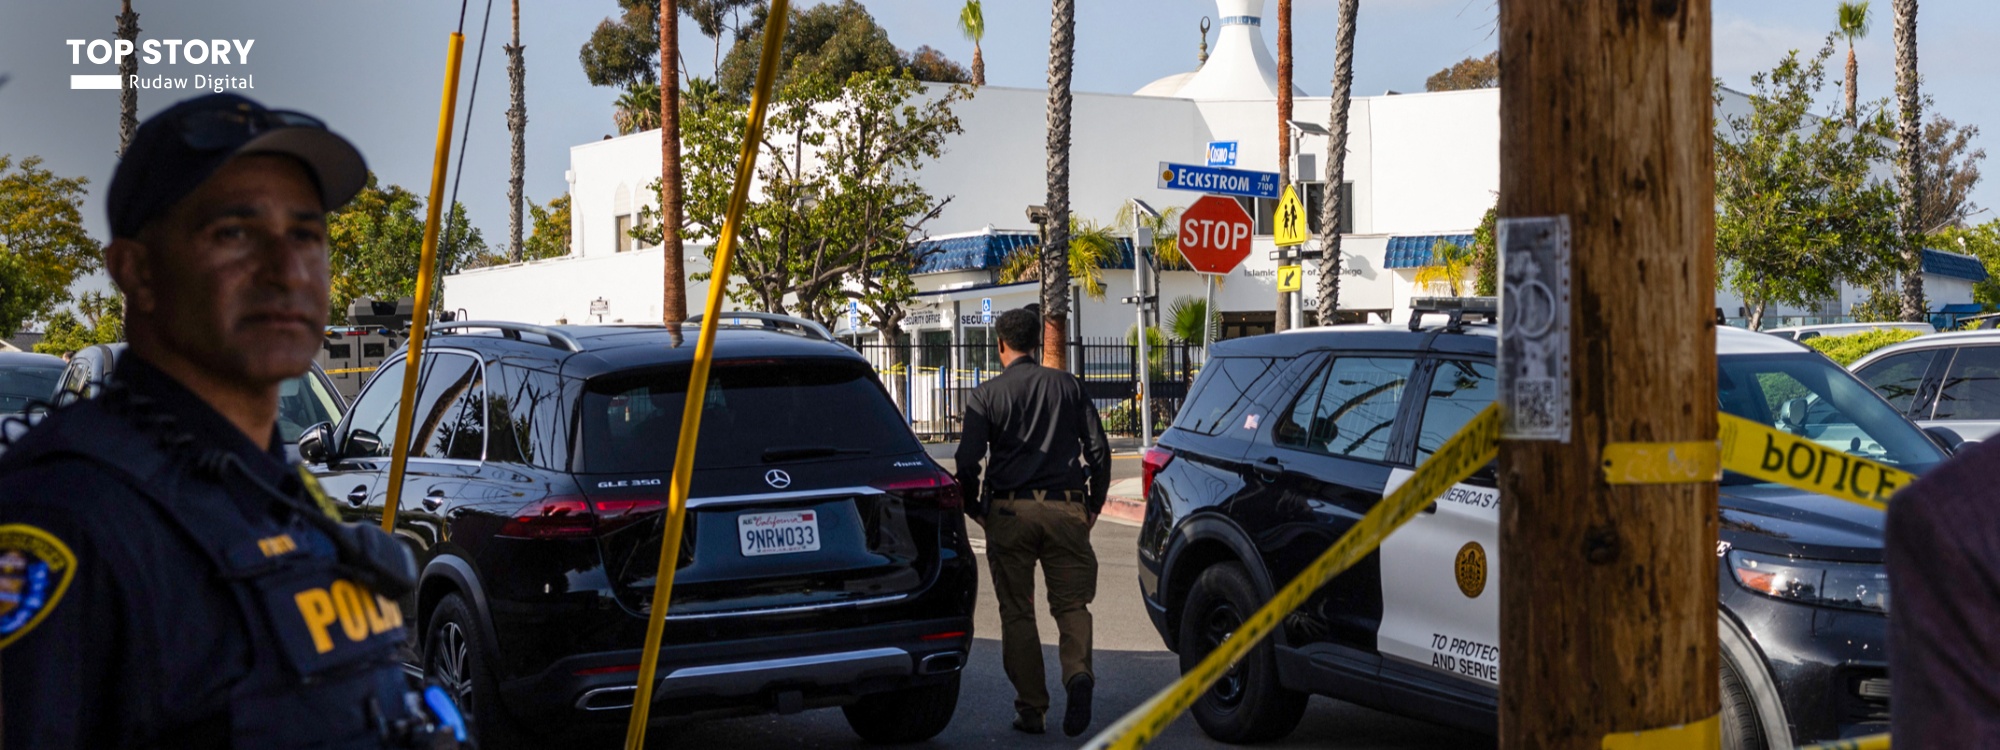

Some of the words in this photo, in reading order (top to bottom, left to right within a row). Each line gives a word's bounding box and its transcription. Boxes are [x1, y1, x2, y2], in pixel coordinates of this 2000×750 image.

[1210, 145, 1228, 164] COSMO
[1177, 168, 1250, 192] ECKSTROM
[1261, 174, 1271, 183] AV
[1257, 182, 1274, 191] 7100
[1182, 218, 1249, 251] STOP
[1244, 269, 1275, 277] Islamic
[925, 313, 941, 324] OFFICE
[598, 480, 628, 488] GLE
[755, 516, 799, 528] California
[746, 525, 815, 550] 9NRW033
[1431, 633, 1448, 650] TO
[1448, 637, 1499, 662] PROTEC
[1432, 652, 1456, 671] AND
[1459, 658, 1498, 681] SERVE
